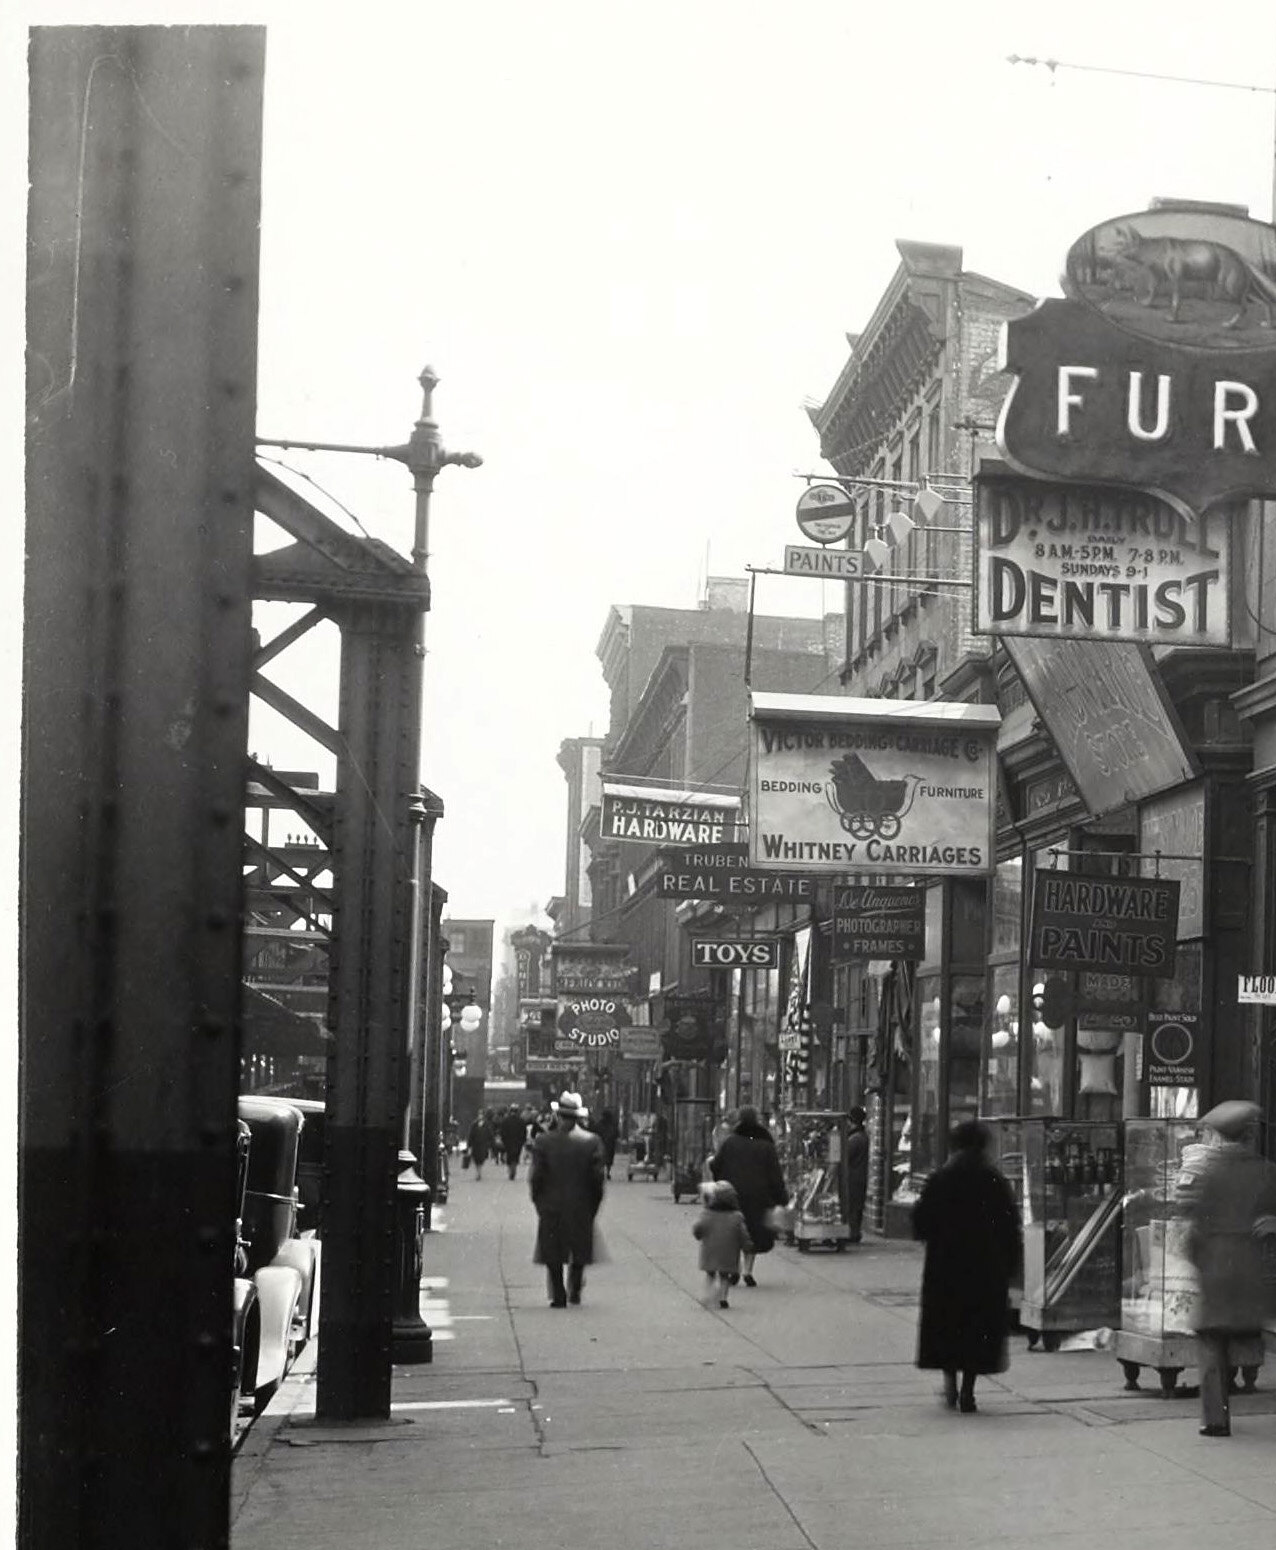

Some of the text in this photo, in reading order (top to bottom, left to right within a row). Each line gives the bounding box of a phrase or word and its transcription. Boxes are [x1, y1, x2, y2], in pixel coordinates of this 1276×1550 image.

[789, 551, 859, 574] PAINTS
[1061, 562, 1121, 578] SUNDAYS
[989, 556, 1220, 632] DENTIST
[762, 729, 824, 754] VICTOR
[829, 732, 888, 750] BEDDING
[895, 735, 960, 760] CARRIAGE
[761, 780, 985, 799] BEDDING FURNITURE
[643, 803, 725, 824] TARZIAN
[612, 815, 724, 844] HARDWARE
[684, 853, 749, 868] TRUBEN
[762, 833, 982, 867] WHITNEY CARRIAGES
[663, 874, 811, 896] REAL ESTATE
[1044, 879, 1170, 922] HARDWARE
[836, 918, 922, 935] PHOTOGRAPHER
[697, 943, 771, 964] TOYS
[852, 939, 905, 954] FRAMES
[1039, 926, 1166, 967] PAINTS
[571, 998, 616, 1015] PHOTO
[568, 1027, 620, 1046] STUDIO
